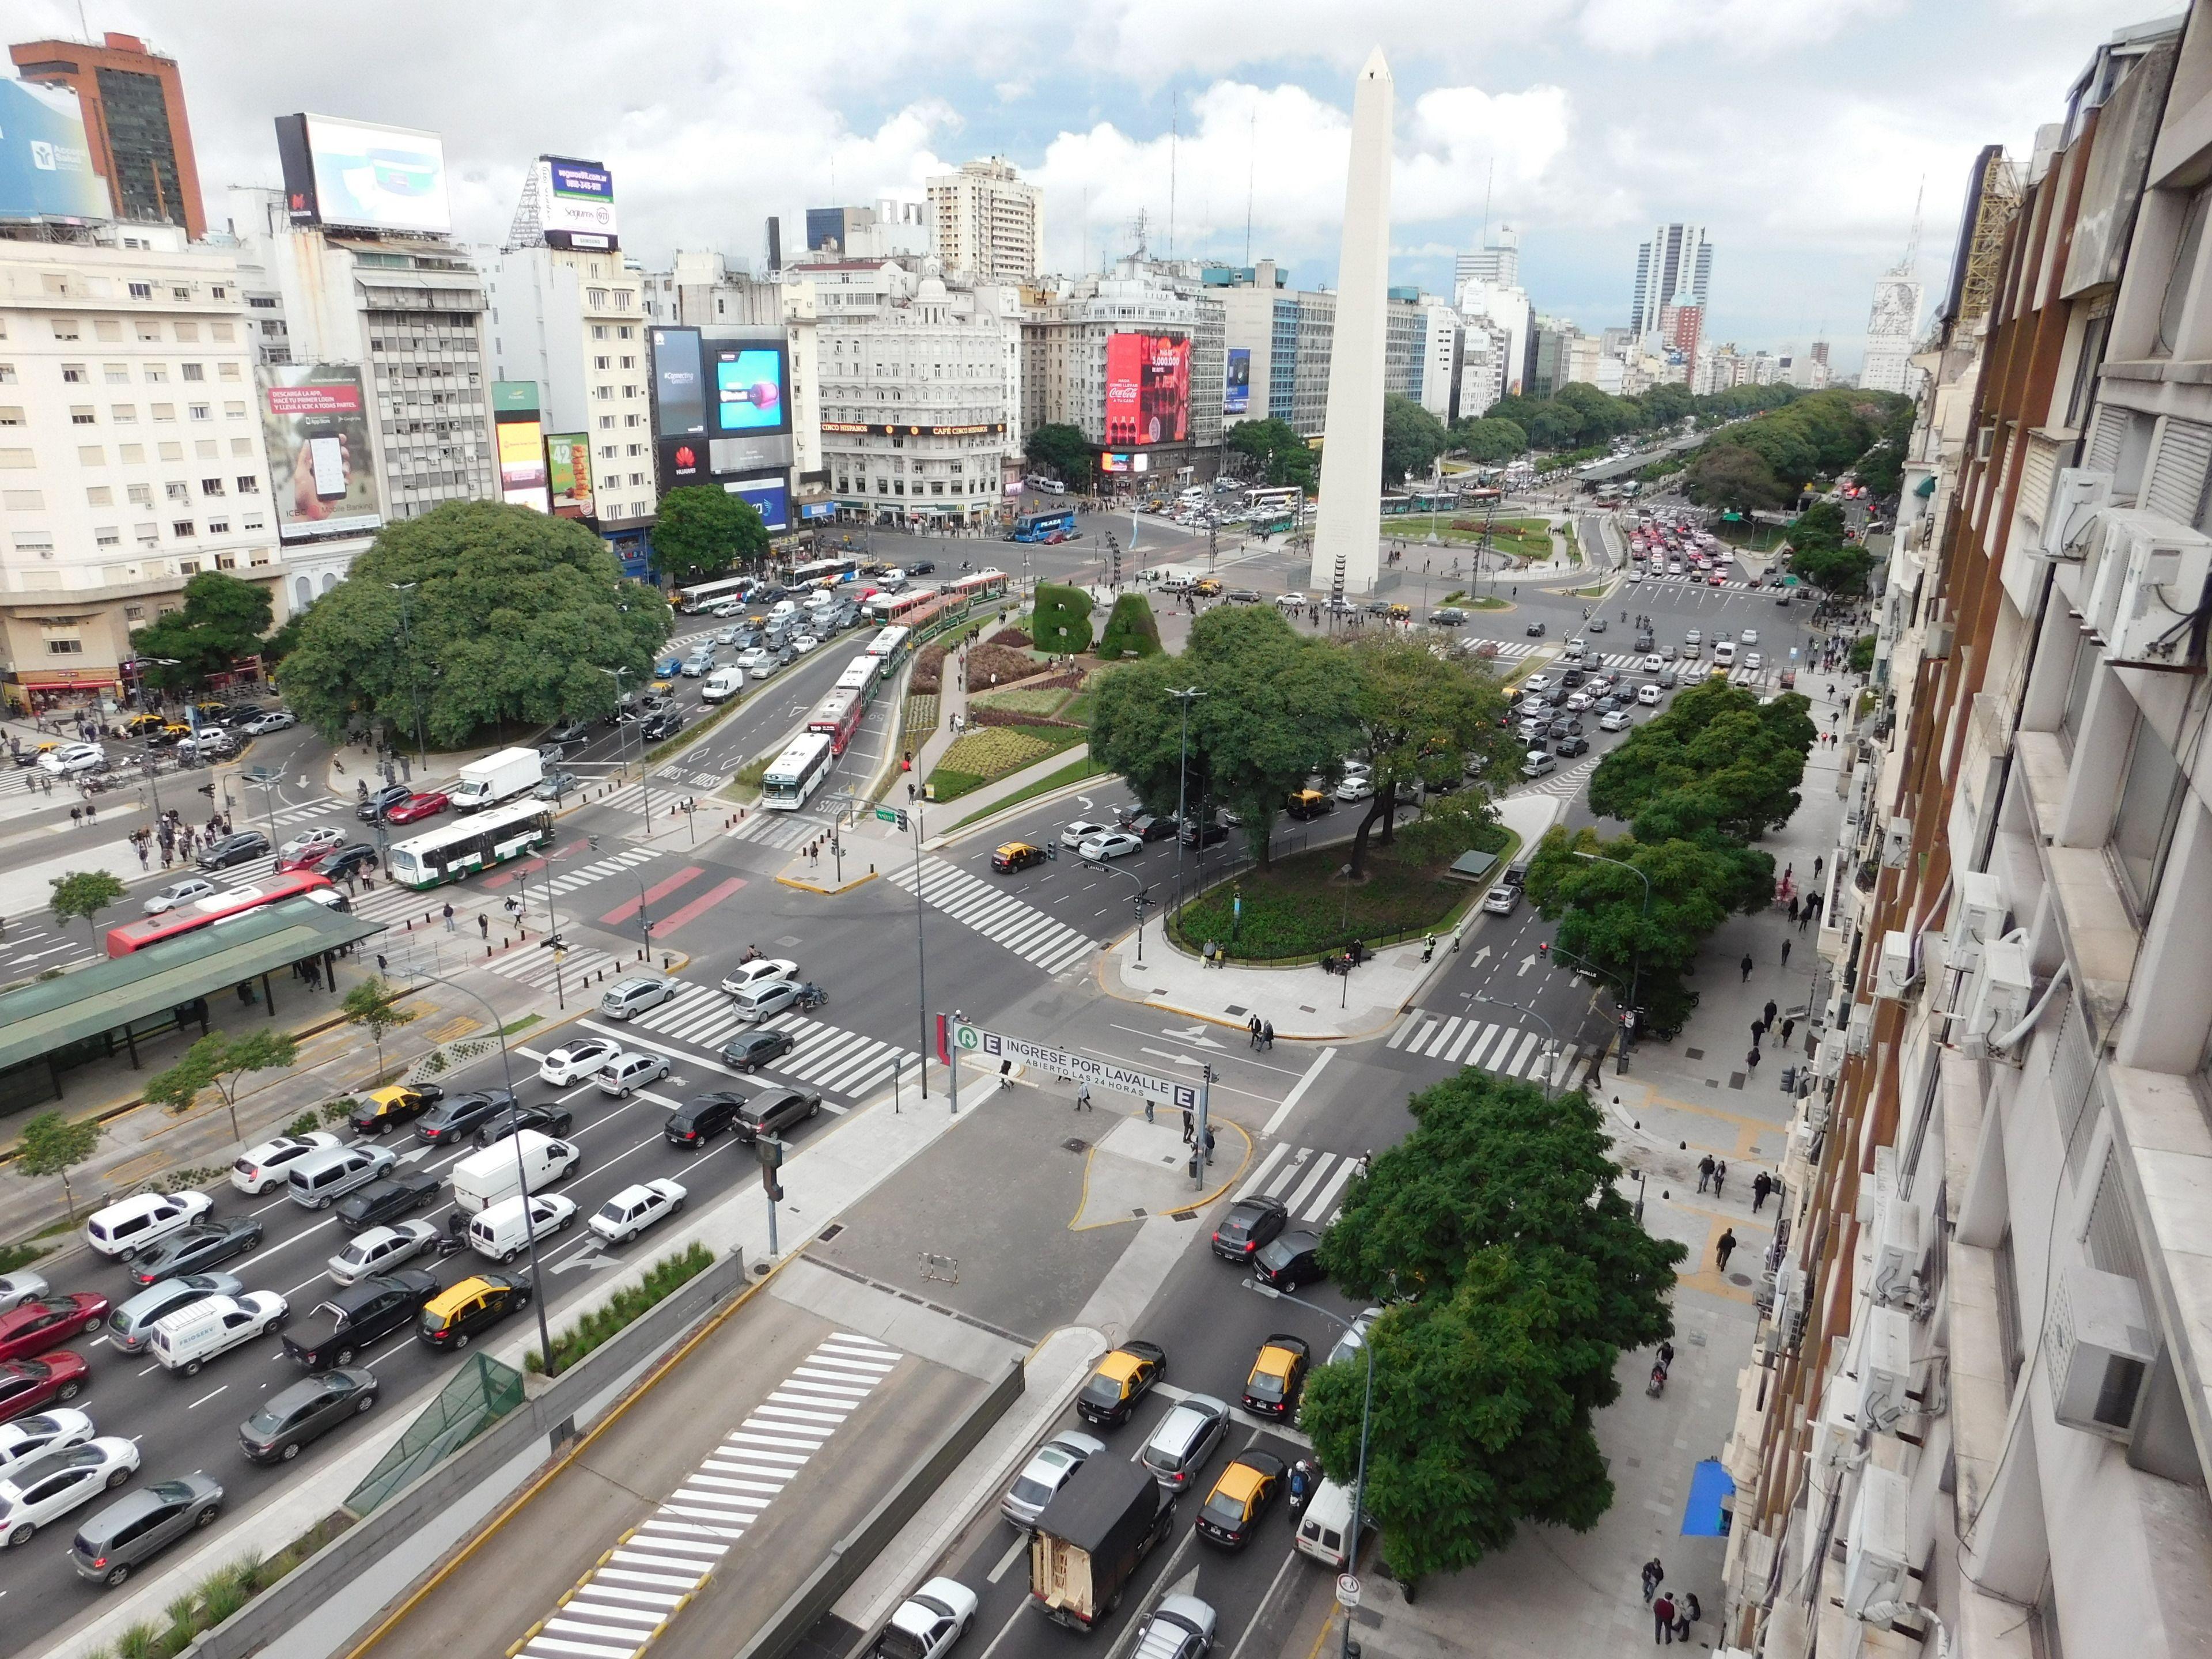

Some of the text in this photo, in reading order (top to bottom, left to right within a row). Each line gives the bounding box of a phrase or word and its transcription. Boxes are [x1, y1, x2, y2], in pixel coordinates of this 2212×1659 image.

[565, 207, 594, 219] Seguros
[1152, 357, 1179, 366] 5.000.000
[554, 445, 571, 464] 42
[346, 503, 373, 511] Banking
[1041, 519, 1061, 527] PLAZA
[656, 766, 688, 779] BUS
[688, 773, 722, 787] BUS
[813, 800, 847, 815] BUS
[1576, 968, 1597, 978] LAVALLE
[1007, 1040, 1067, 1066] INGRESE
[1072, 1058, 1101, 1075] POR
[1106, 1067, 1169, 1094] LAVALLE
[1026, 1059, 1069, 1075] ABIERTO
[1072, 1071, 1091, 1081] LAS
[1108, 1082, 1144, 1096] HORAS
